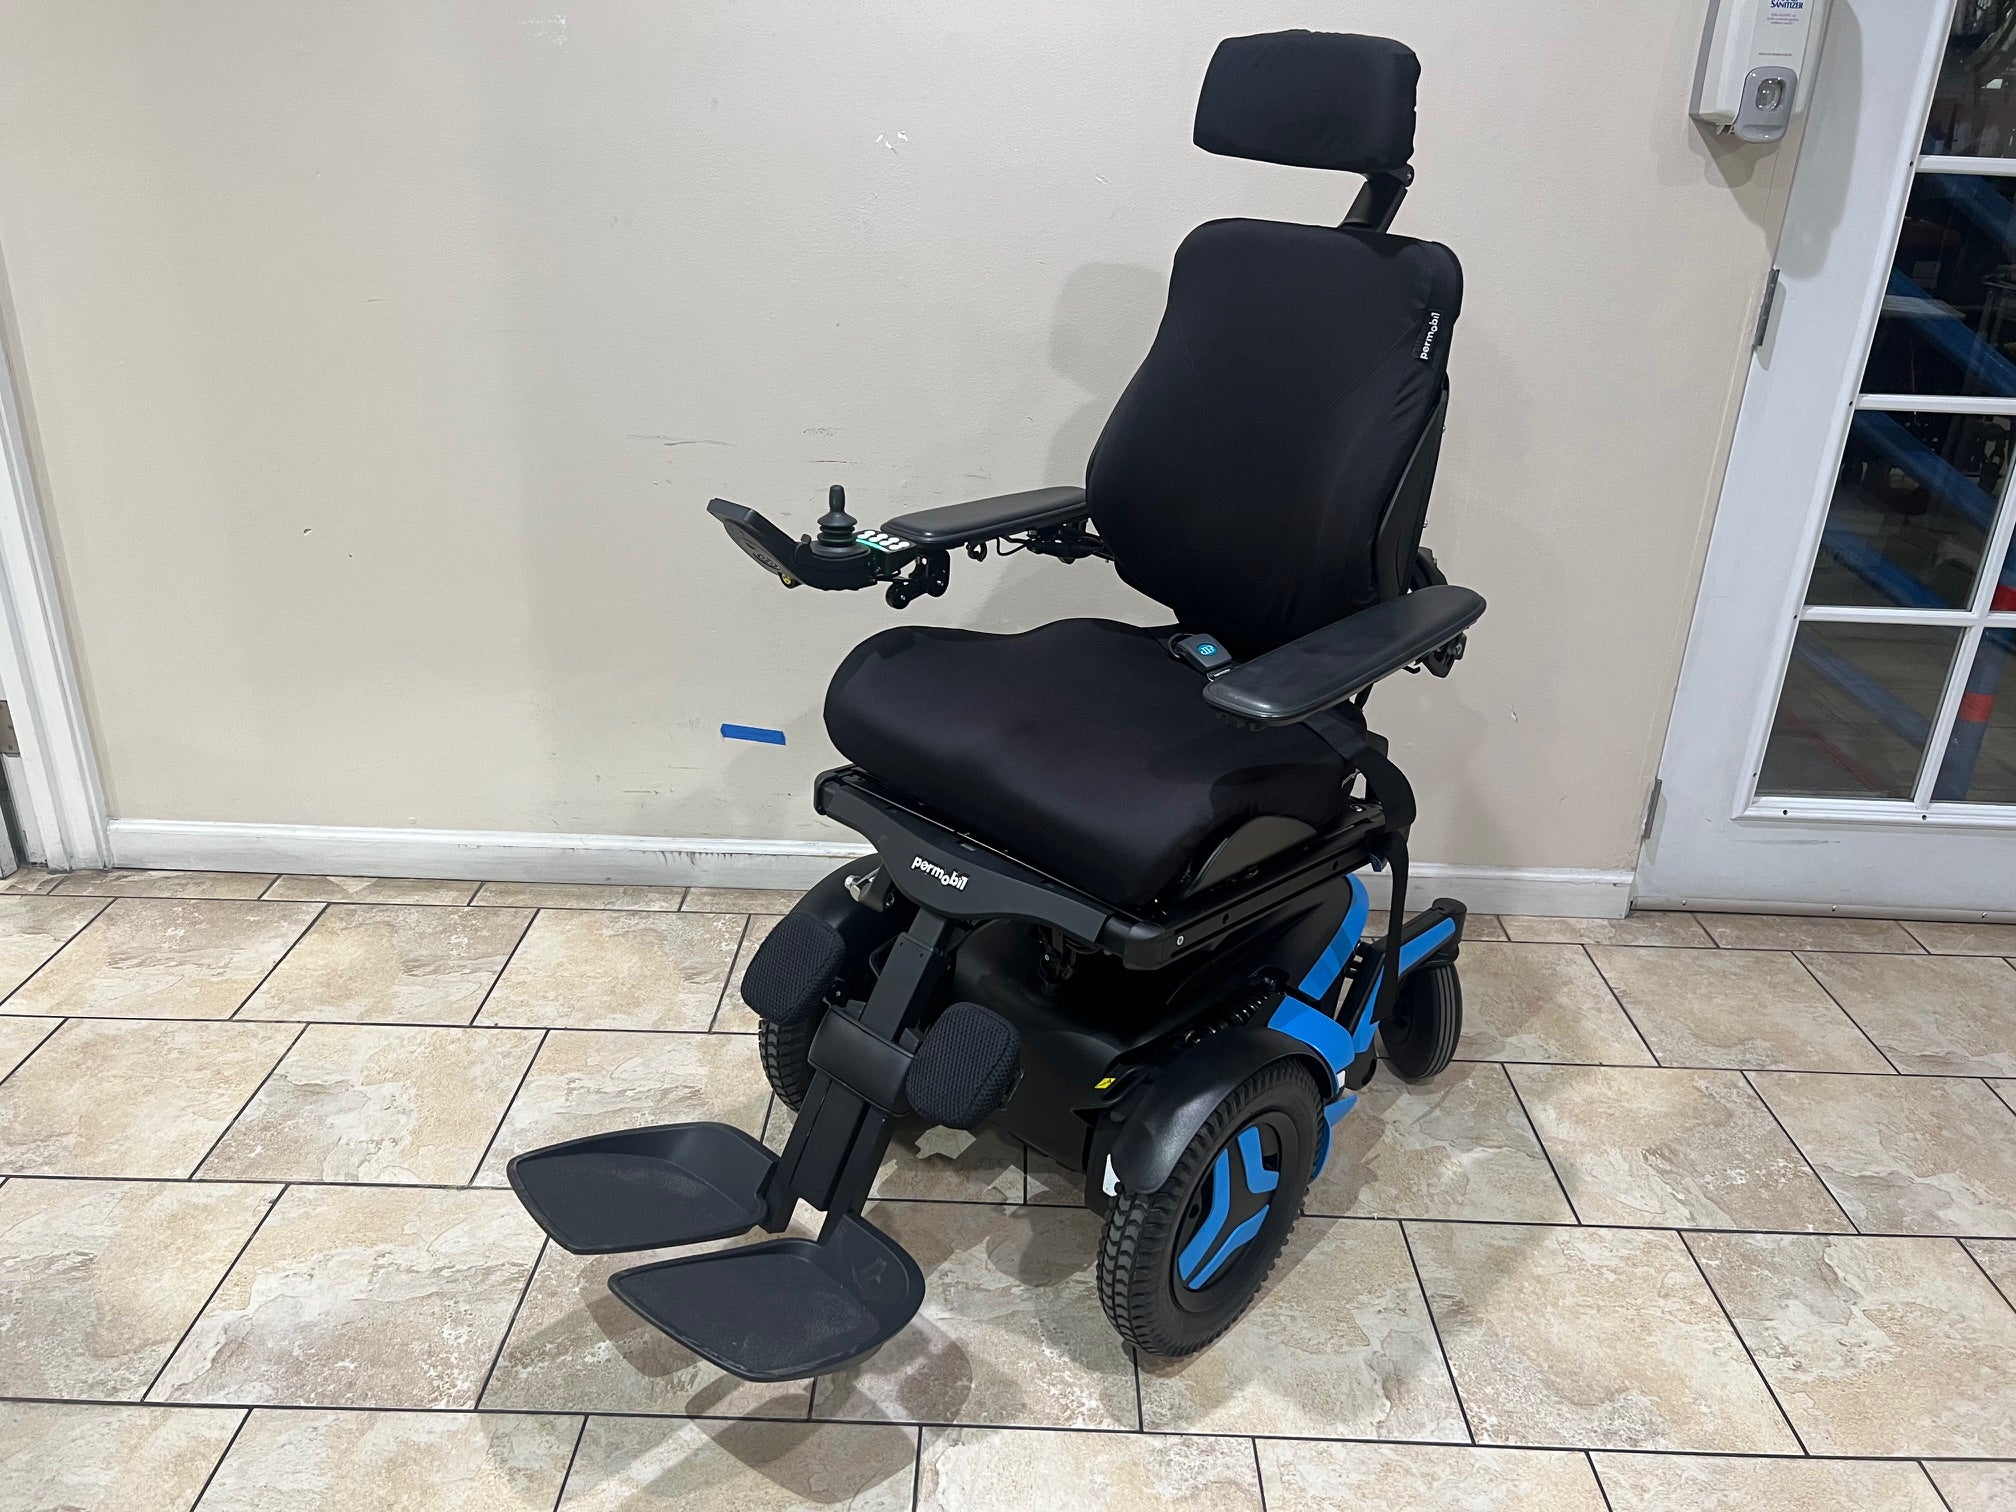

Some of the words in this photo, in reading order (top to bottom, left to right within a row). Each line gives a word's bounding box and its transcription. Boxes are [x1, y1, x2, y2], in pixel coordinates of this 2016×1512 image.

[1770, 1, 1804, 9] SANITIZER
[1420, 312, 1440, 360] permobil
[911, 856, 969, 891] permobil
